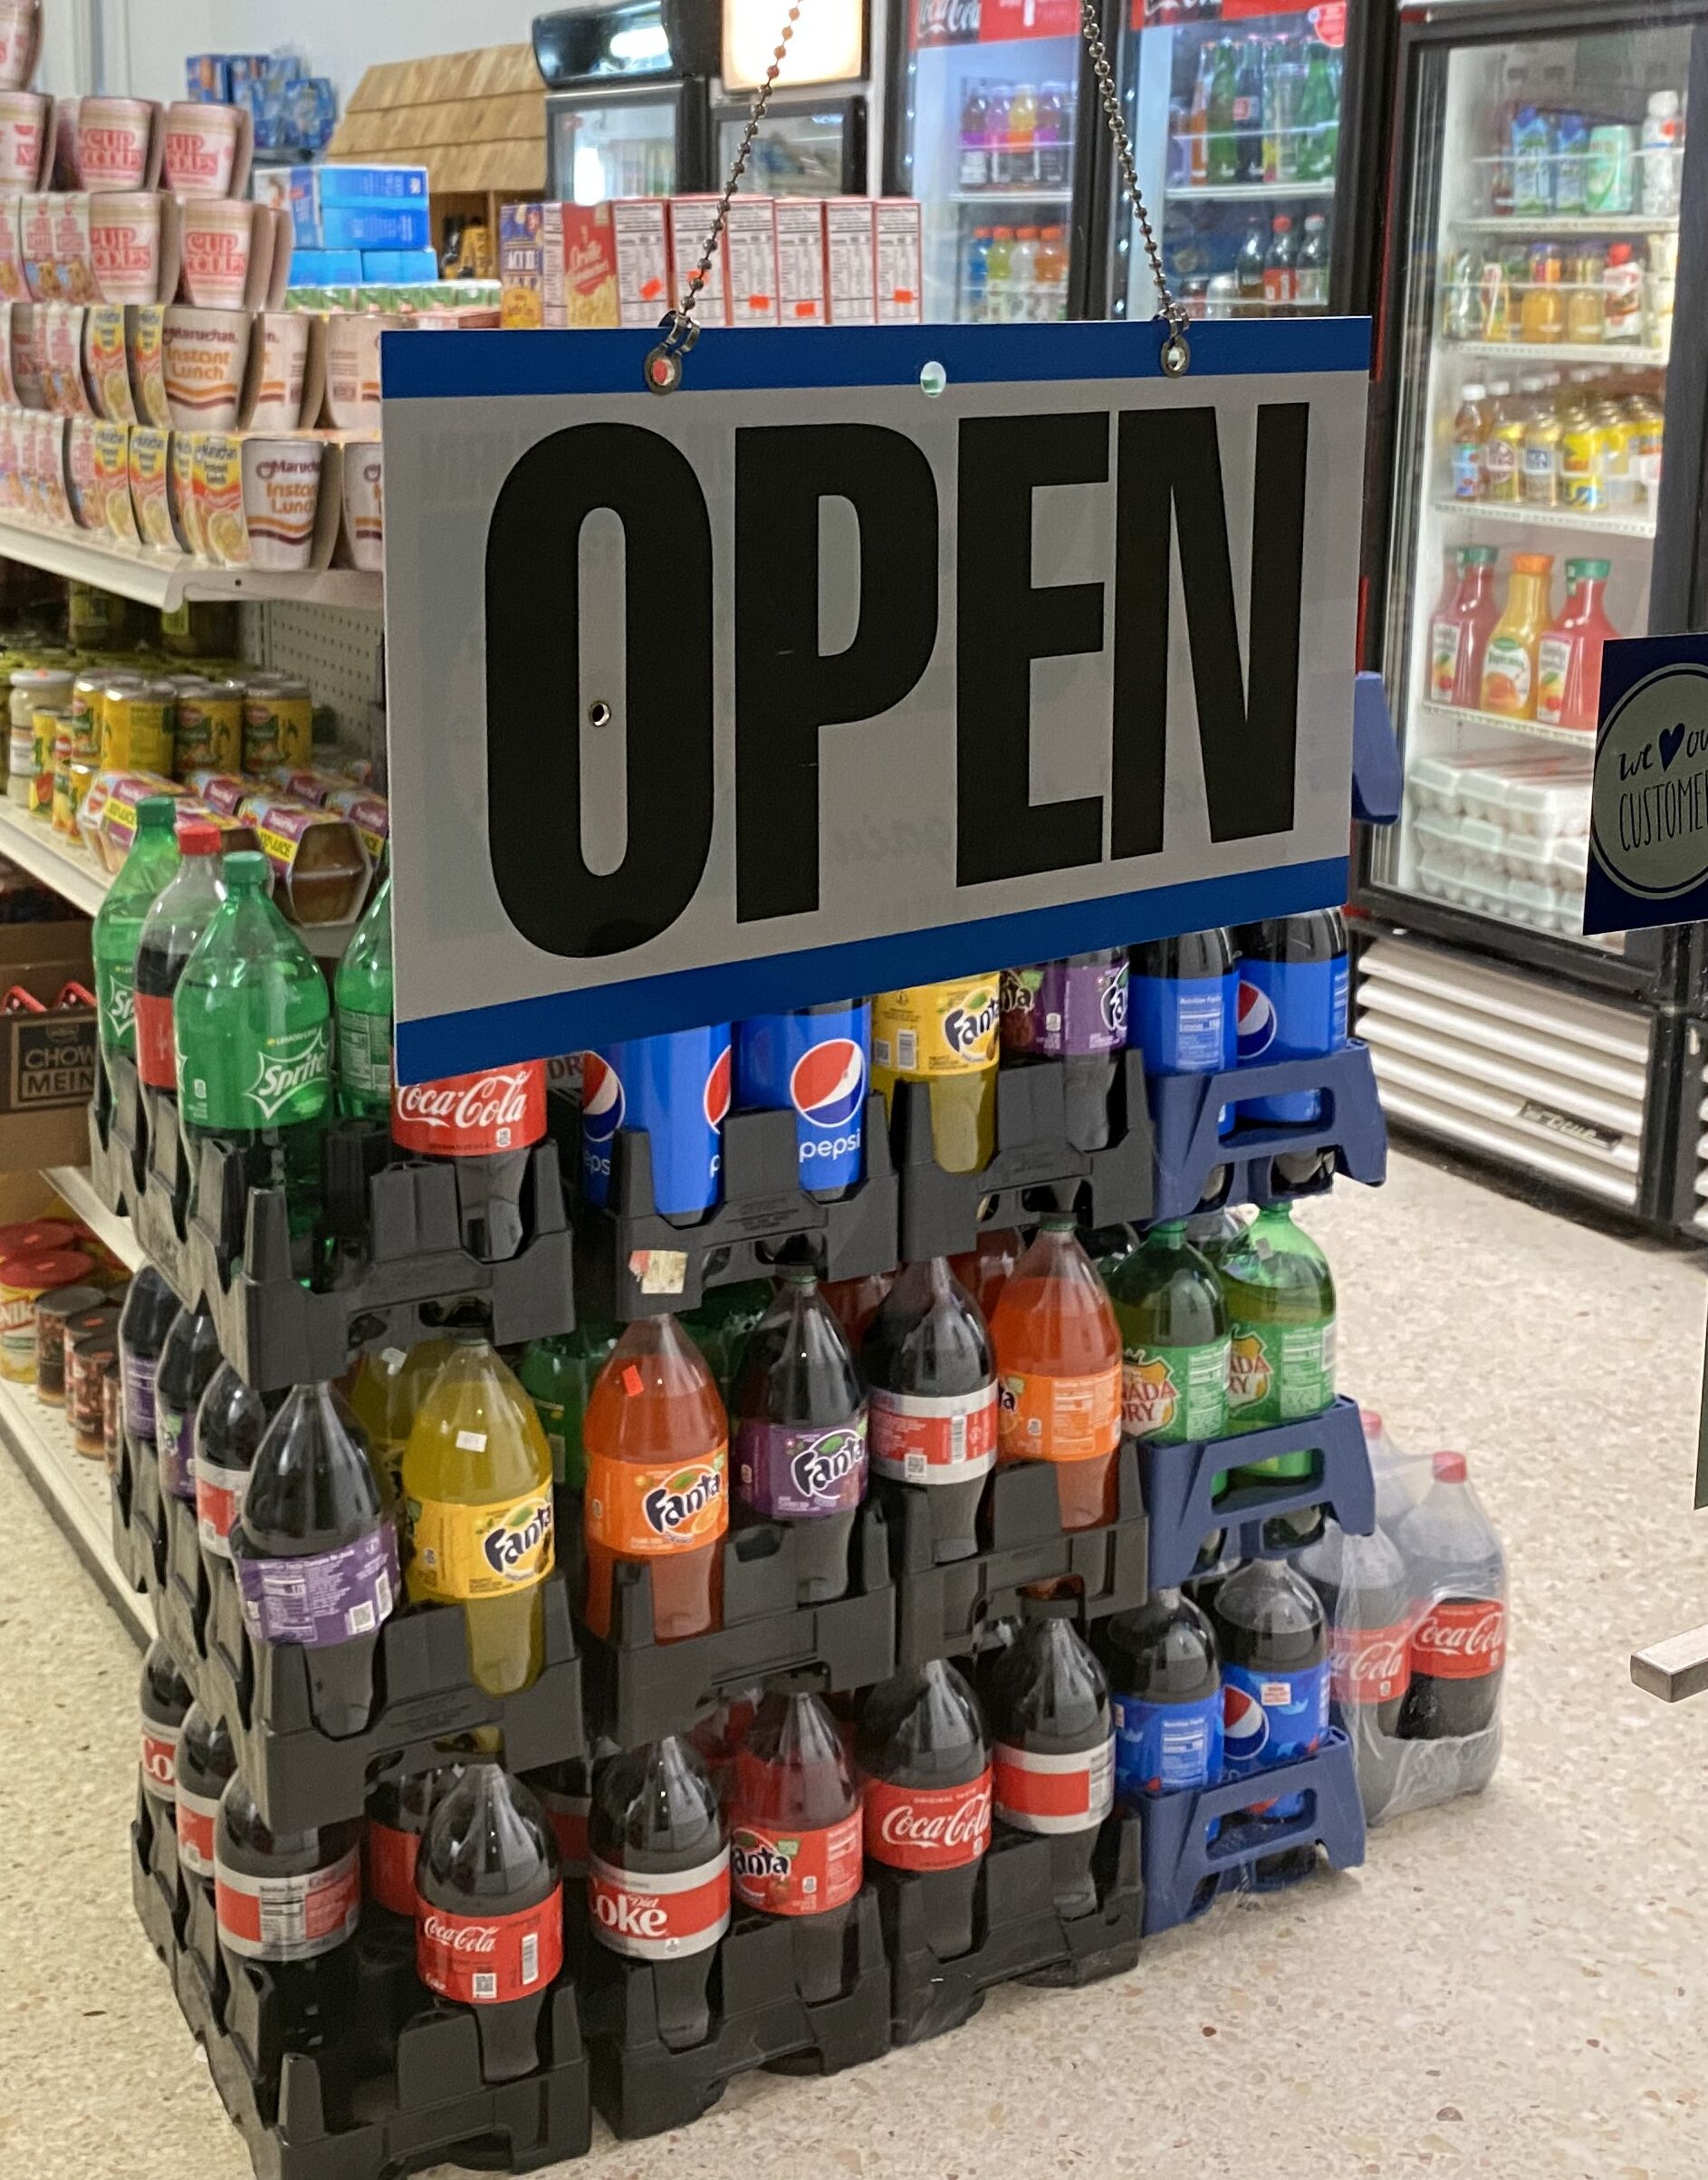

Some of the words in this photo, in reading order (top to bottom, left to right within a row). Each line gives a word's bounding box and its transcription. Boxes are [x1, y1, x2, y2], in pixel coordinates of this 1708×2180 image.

[485, 401, 1309, 958] OPEN
[1618, 744, 1655, 781] we
[1687, 729, 1708, 758] ou
[1619, 770, 1708, 852] CUSTOME
[945, 997, 999, 1053] Fant
[397, 1069, 533, 1129] Coca-Cola
[799, 1128, 861, 1163] pepsi
[645, 1474, 721, 1533] Fanta
[734, 1846, 792, 1877] anta
[423, 1916, 502, 1953] Coca-Cola
[595, 1893, 668, 1937] oke
